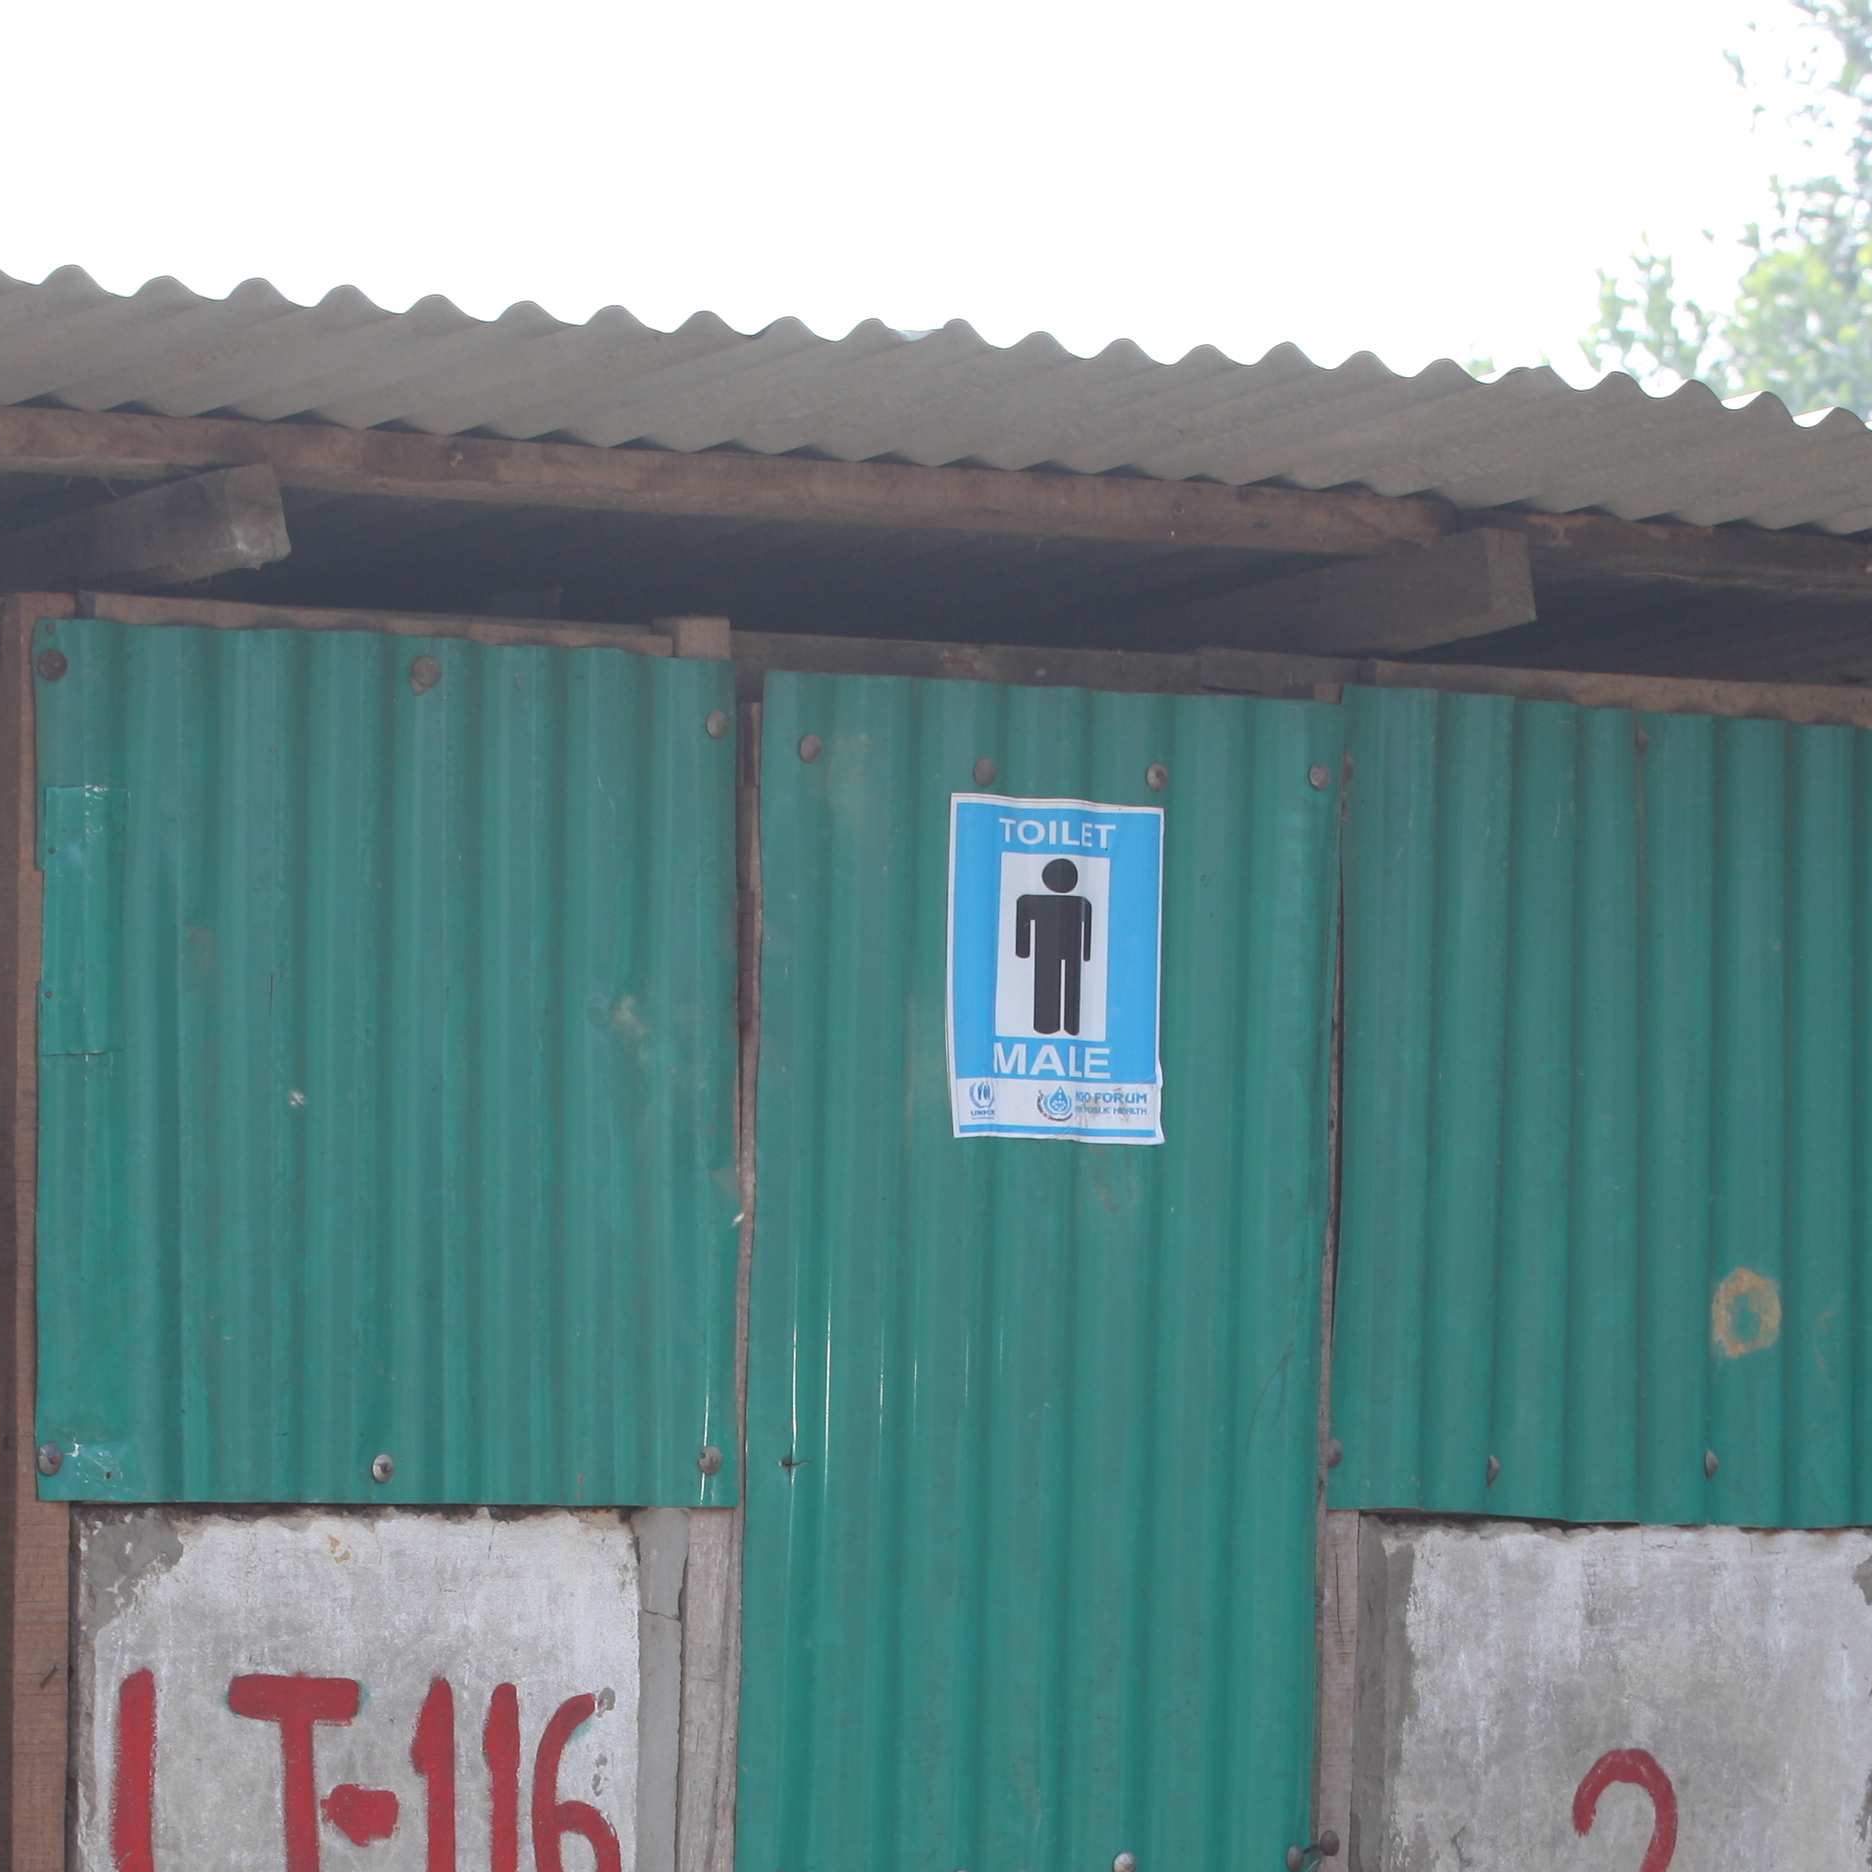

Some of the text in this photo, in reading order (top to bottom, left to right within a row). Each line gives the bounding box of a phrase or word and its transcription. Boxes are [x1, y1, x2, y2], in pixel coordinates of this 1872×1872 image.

[998, 817, 1117, 849] TOILET
[993, 1042, 1112, 1080] MALE
[1093, 1091, 1147, 1104] FORUM
